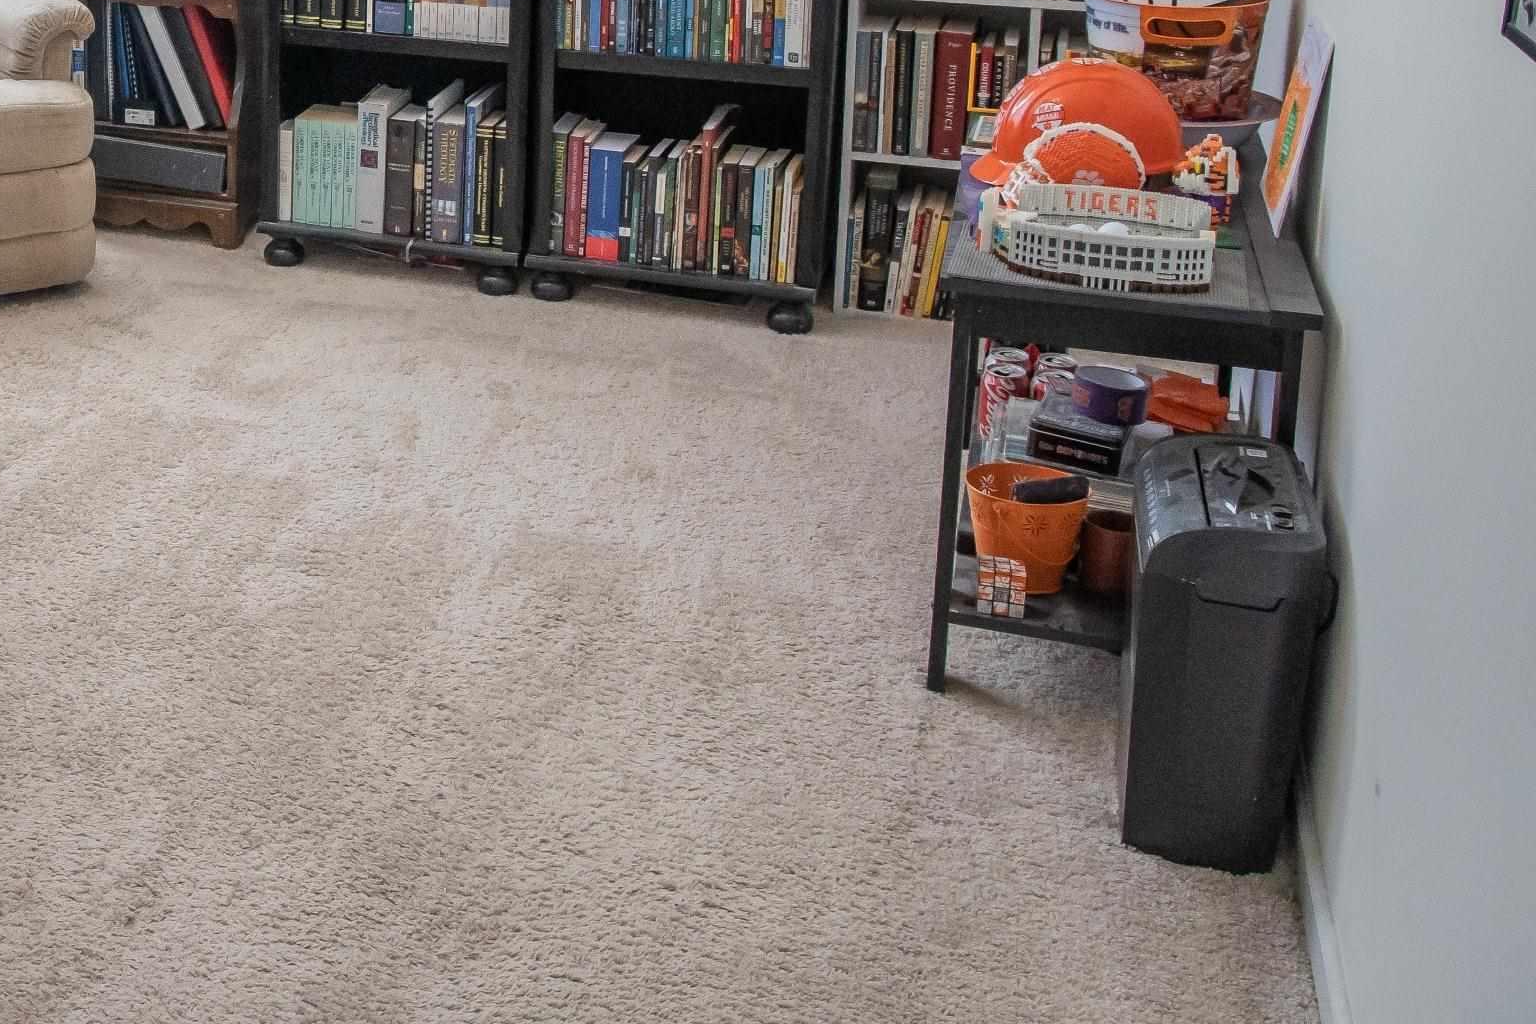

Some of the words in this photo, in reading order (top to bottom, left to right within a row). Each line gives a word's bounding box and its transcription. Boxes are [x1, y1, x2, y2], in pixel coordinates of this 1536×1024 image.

[943, 64, 957, 131] PROVIDENCE
[994, 61, 1002, 102] RADICAL
[438, 131, 448, 184] THEOLOGY
[448, 129, 458, 185] SYSTEMATIC
[1065, 190, 1158, 221] TIGERS
